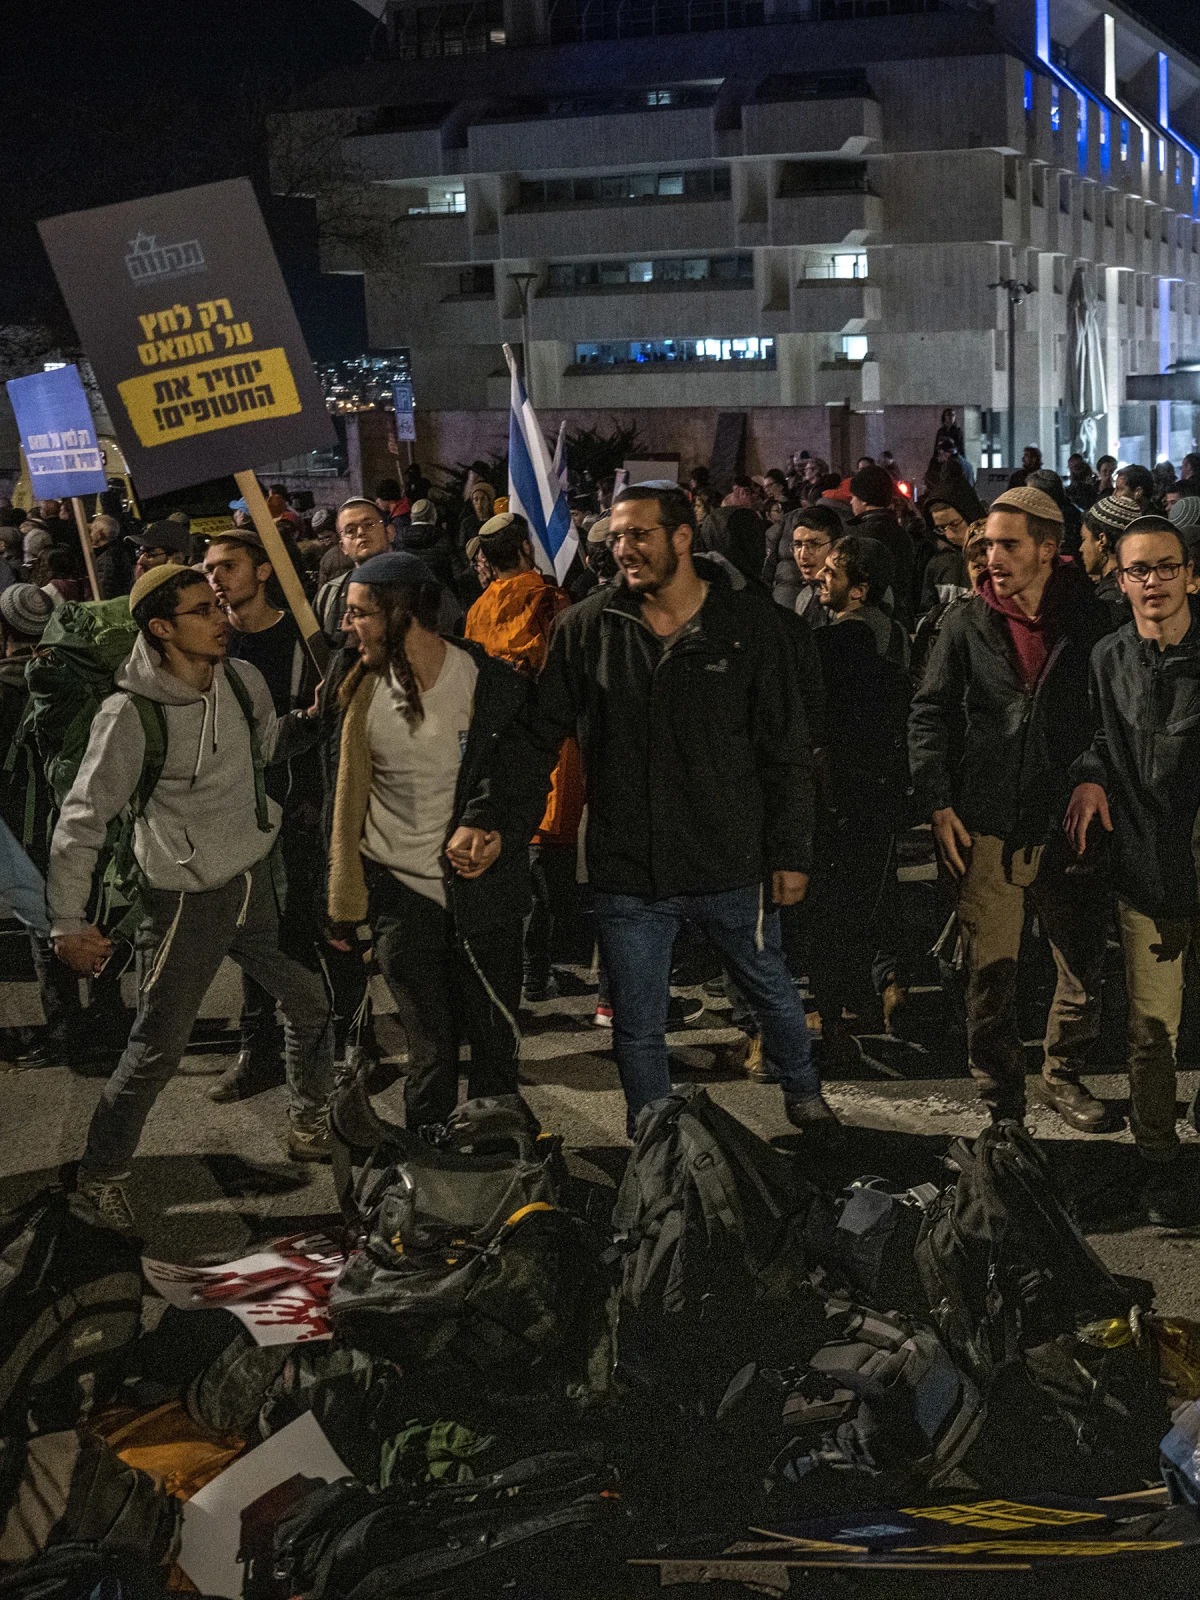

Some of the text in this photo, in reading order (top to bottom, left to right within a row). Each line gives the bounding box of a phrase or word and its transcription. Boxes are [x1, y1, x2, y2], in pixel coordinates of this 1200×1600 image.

[137, 298, 234, 342] רק לחץ
[137, 321, 254, 366] על חמאס
[153, 359, 263, 405] יחזיר את
[152, 384, 276, 432] החטופים!
